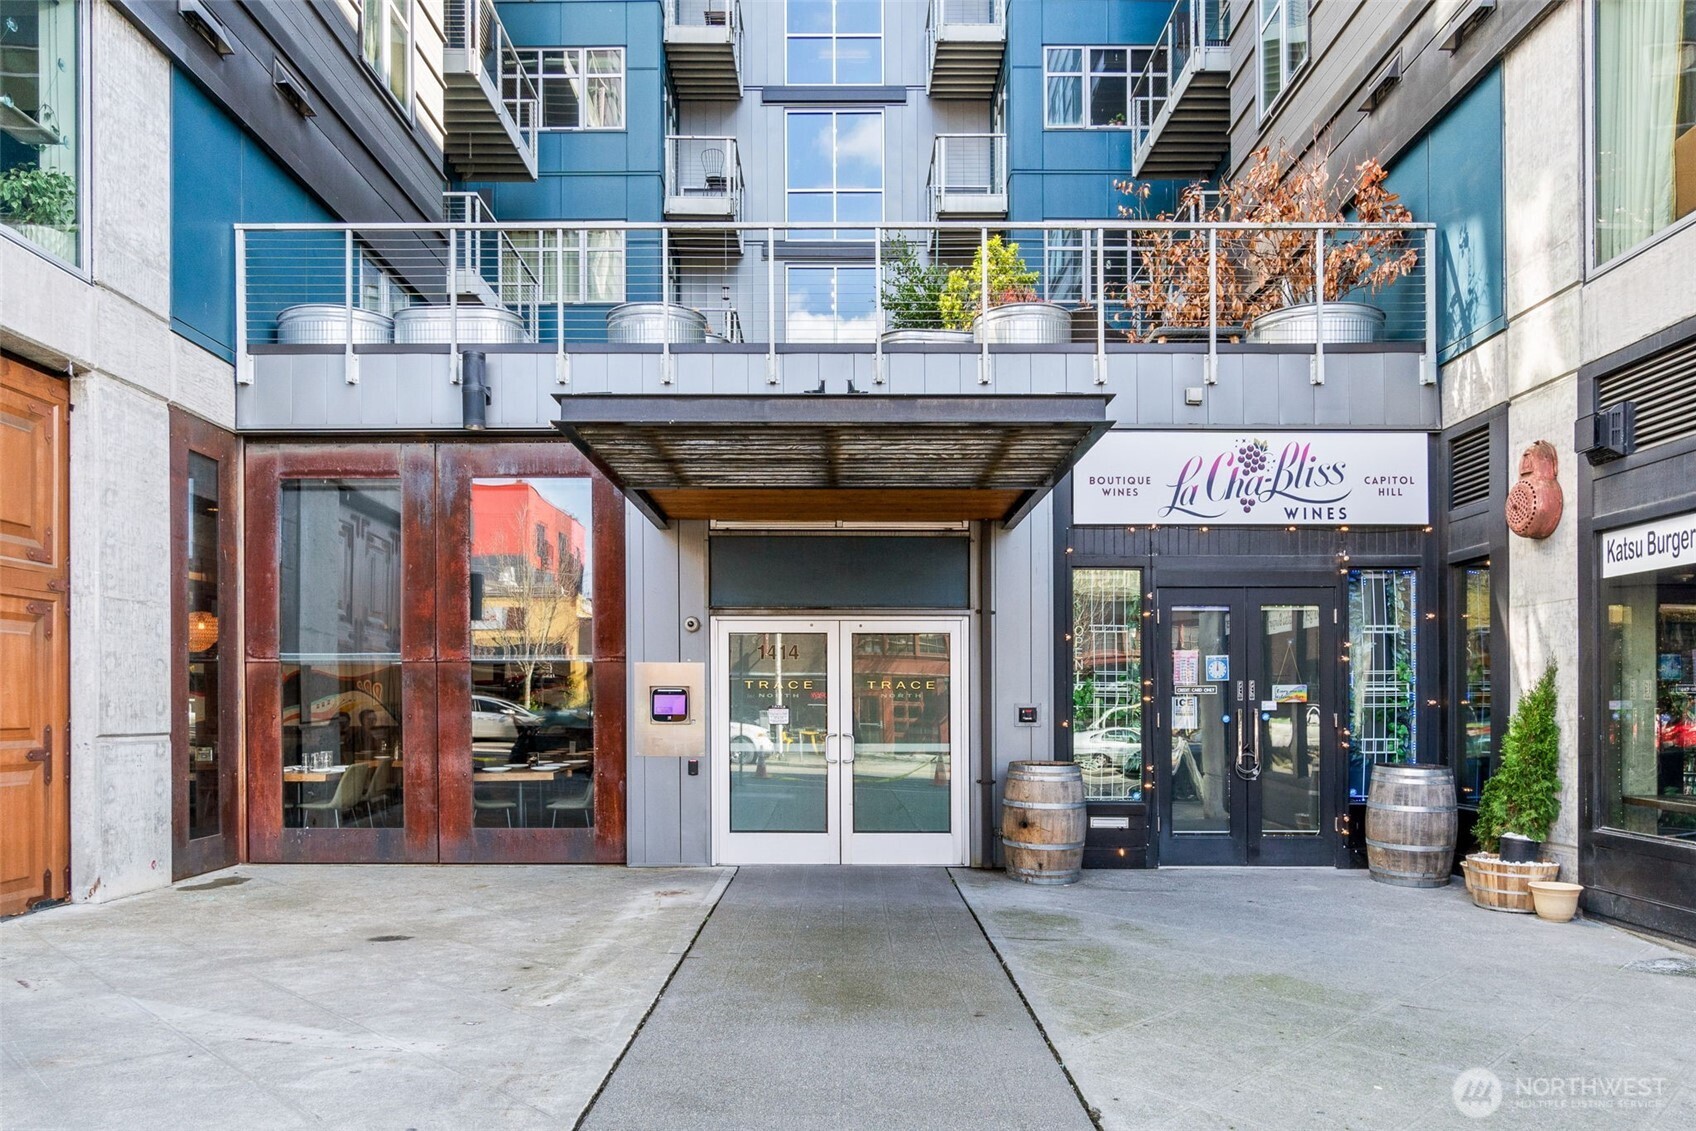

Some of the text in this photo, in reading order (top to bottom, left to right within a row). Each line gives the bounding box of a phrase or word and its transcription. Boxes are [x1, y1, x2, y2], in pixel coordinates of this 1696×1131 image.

[1088, 475, 1152, 486] BOUTIQUE
[1364, 475, 1416, 486] CAPITOL
[1101, 487, 1140, 498] WINES
[1158, 455, 1229, 519] La
[1378, 487, 1404, 498] HILL
[1283, 506, 1348, 521] WINES
[1607, 528, 1696, 563] Katsu Burger
[757, 644, 799, 660] 1414
[744, 680, 813, 690] TRACE
[867, 680, 936, 690] TRACE
